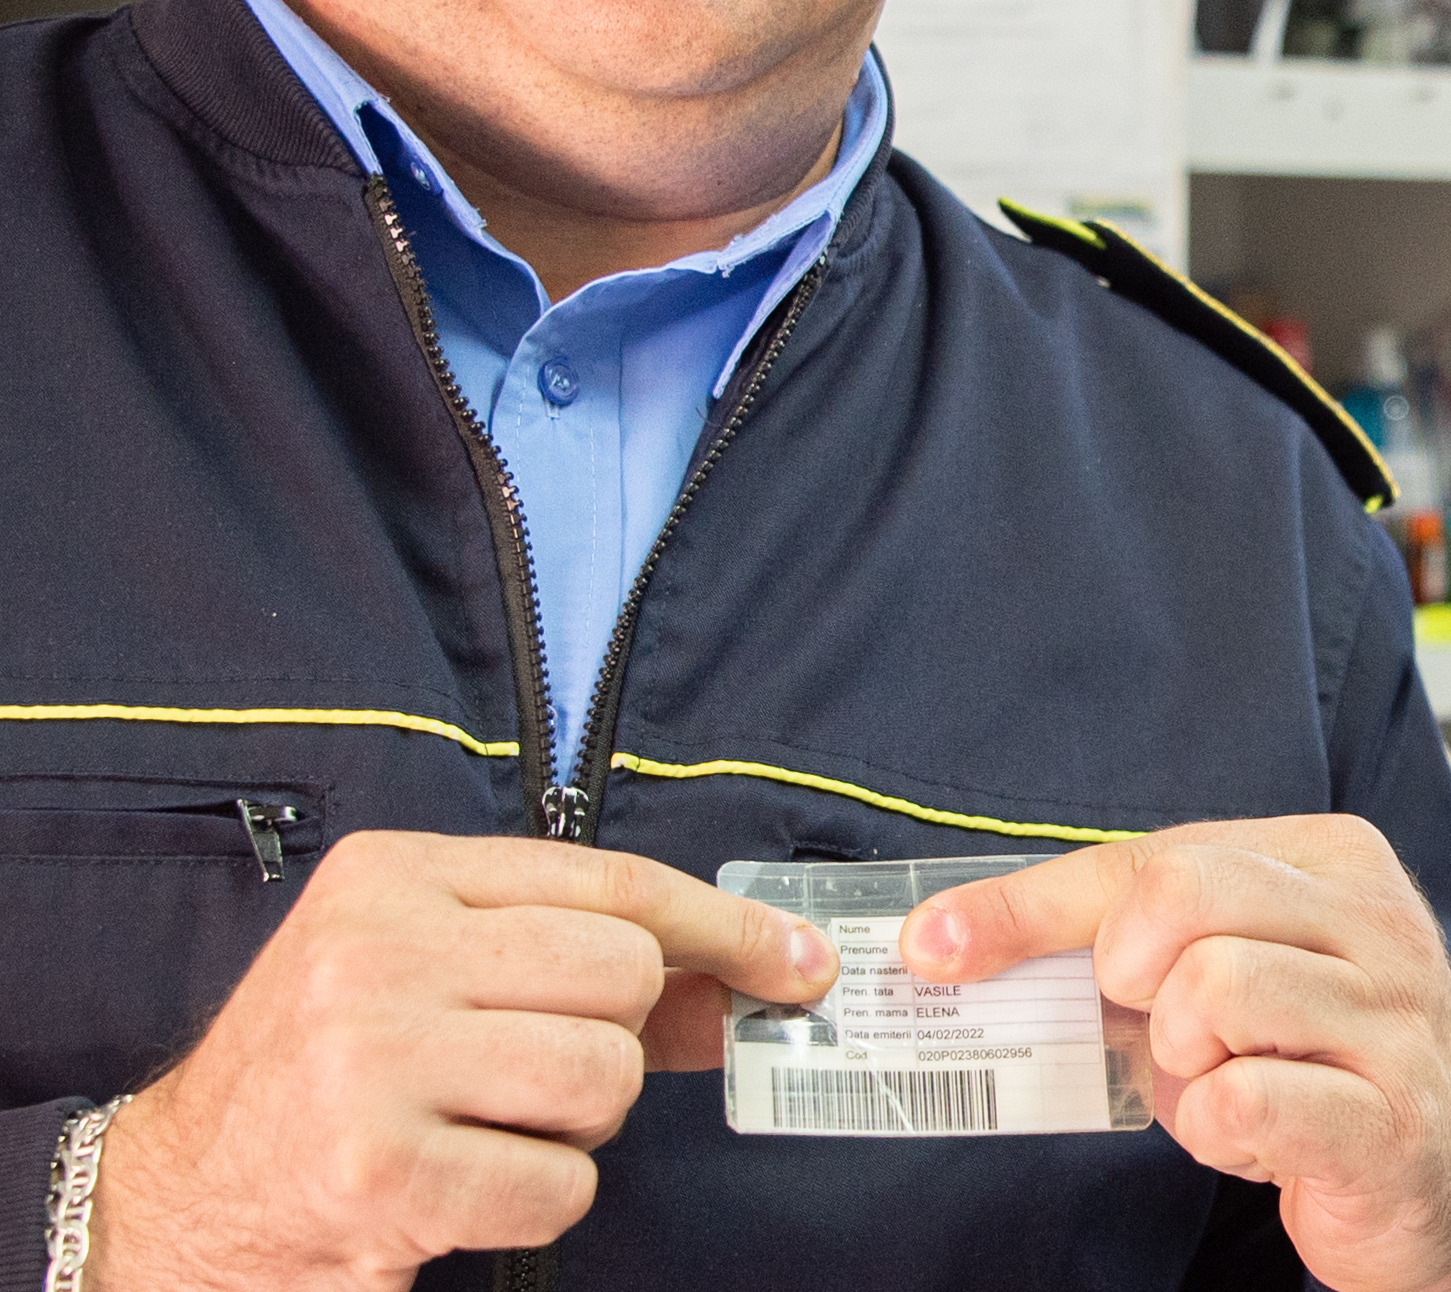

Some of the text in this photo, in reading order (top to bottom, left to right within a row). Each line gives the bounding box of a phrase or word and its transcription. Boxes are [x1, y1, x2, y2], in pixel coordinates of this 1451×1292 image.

[839, 924, 871, 935] Nume
[840, 944, 889, 955] Prenume
[841, 965, 908, 976] Data nasterii
[874, 987, 894, 997] tata
[914, 985, 962, 997] VASILE
[875, 1008, 908, 1018] mama
[916, 1006, 960, 1018] ELENA
[845, 1028, 984, 1040] Data emiterii 04/02/2022
[845, 1047, 1033, 1062] Cod 020P02380602956
